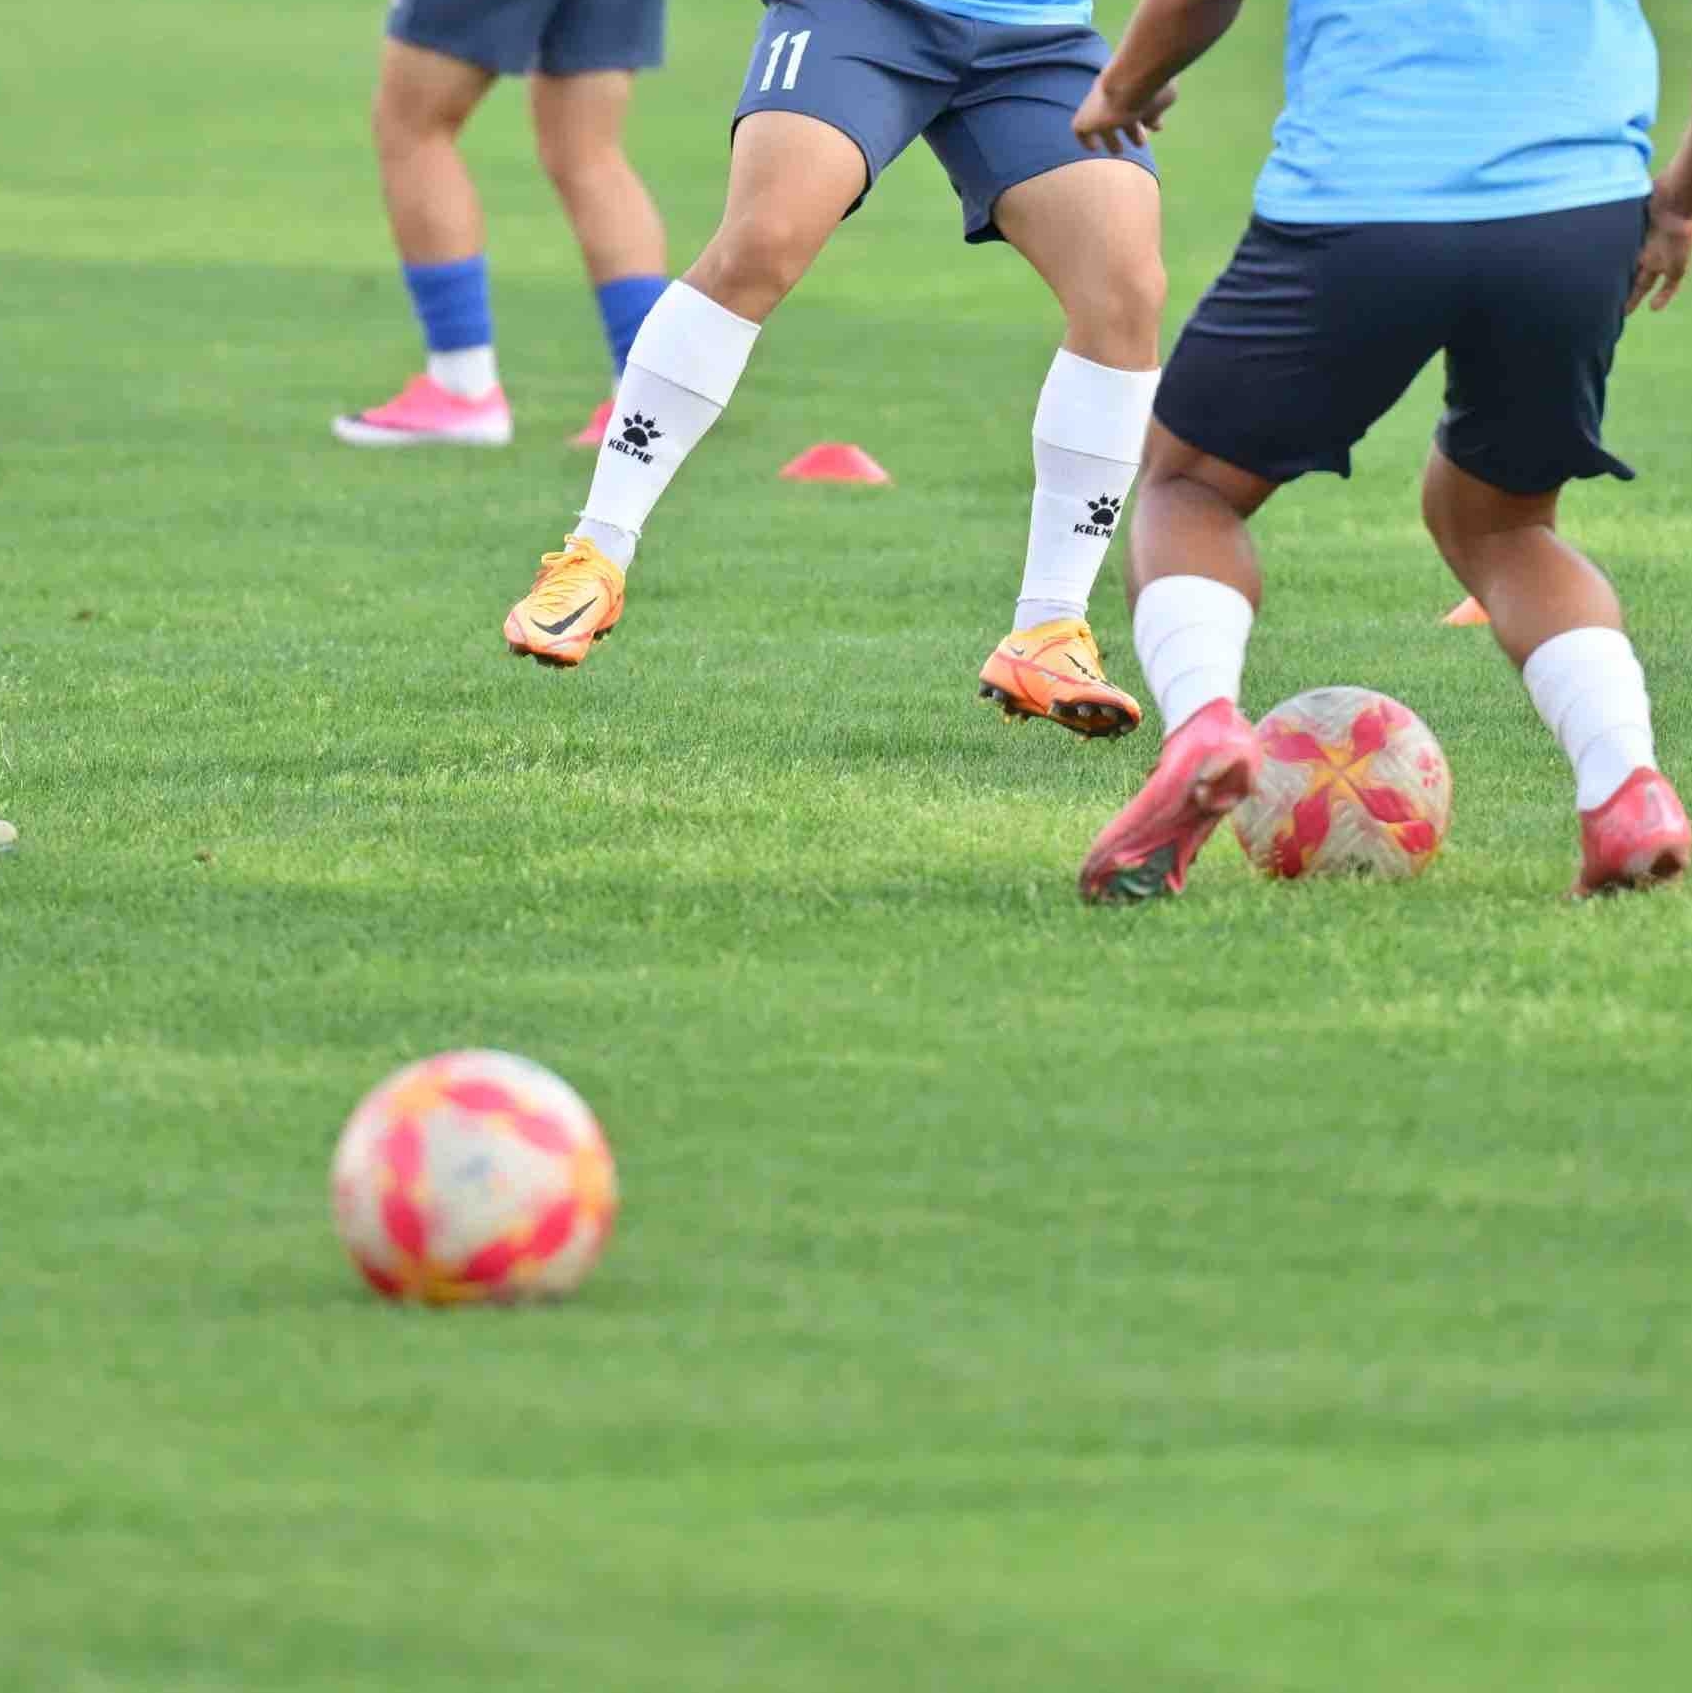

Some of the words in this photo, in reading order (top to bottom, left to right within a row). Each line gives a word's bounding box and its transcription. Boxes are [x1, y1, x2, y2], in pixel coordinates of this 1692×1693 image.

[759, 30, 812, 92] 11
[607, 438, 654, 465] KELME
[1073, 523, 1114, 539] KELM
